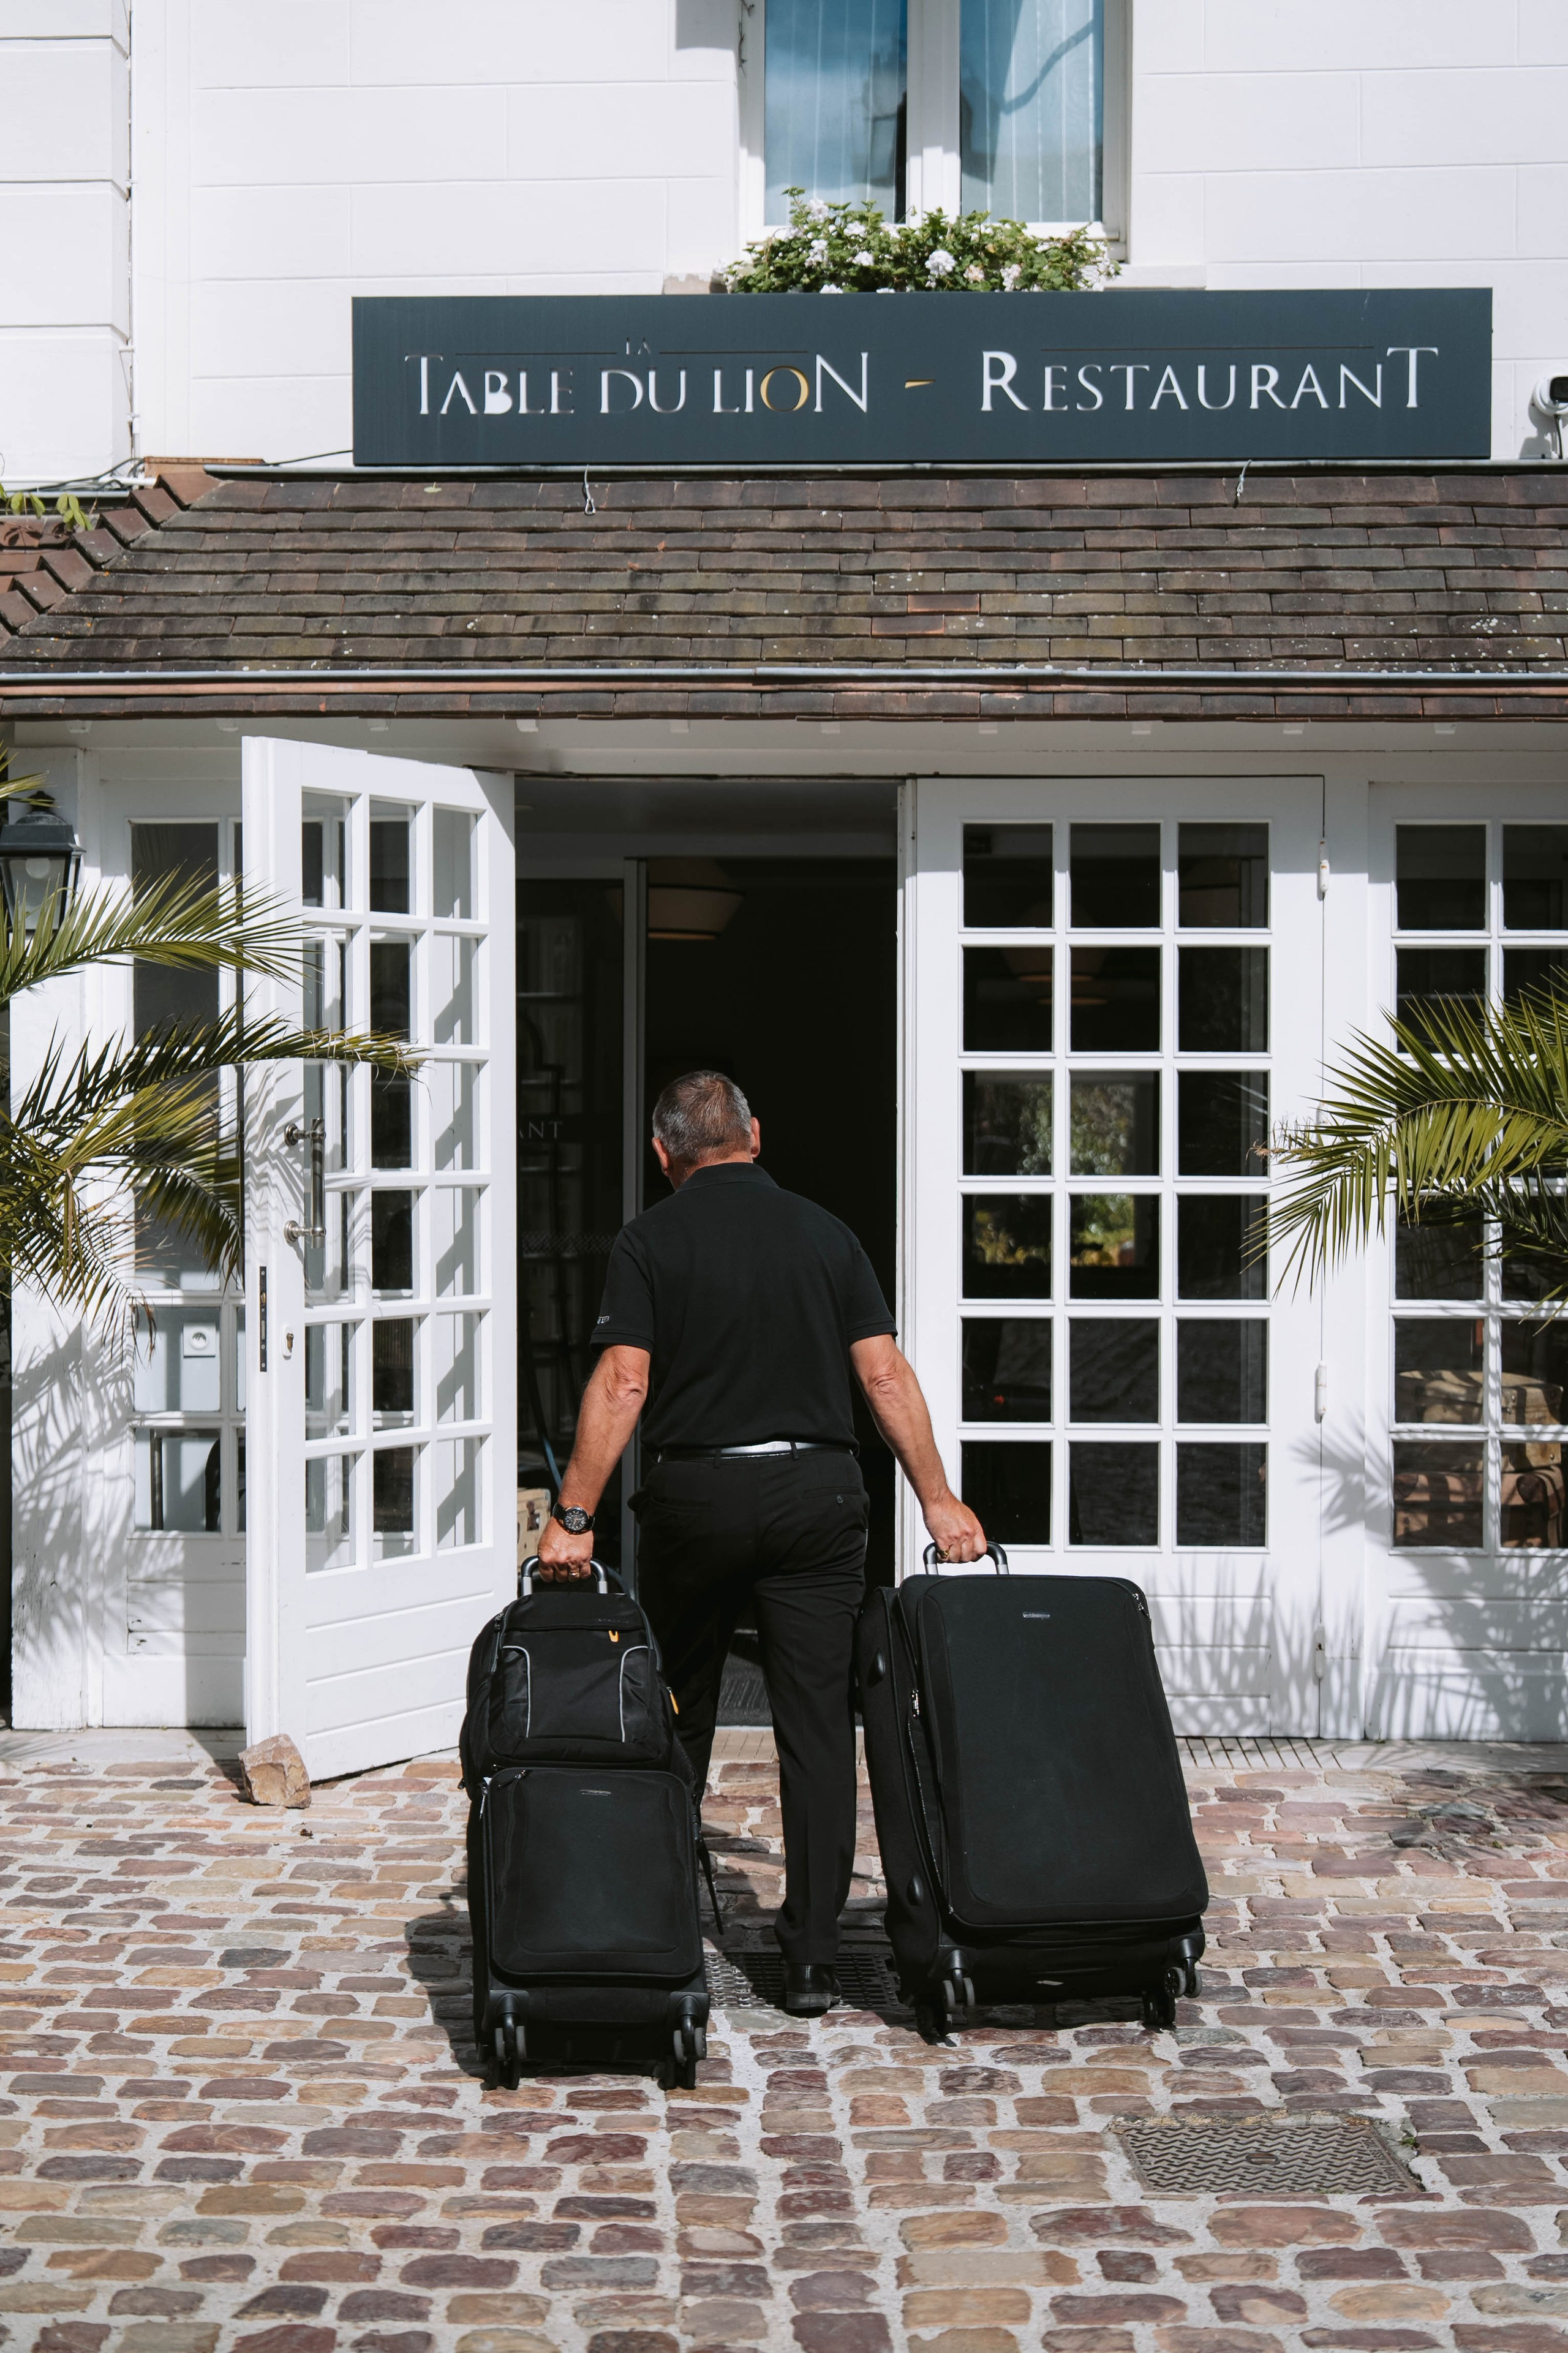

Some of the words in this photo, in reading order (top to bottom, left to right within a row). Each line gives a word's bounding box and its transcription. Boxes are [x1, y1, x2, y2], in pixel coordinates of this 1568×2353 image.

[625, 336, 652, 356] LA
[404, 354, 575, 415] TABLE
[599, 366, 687, 414] DU
[712, 351, 869, 414] LION
[979, 346, 1439, 412] RESTAURANT
